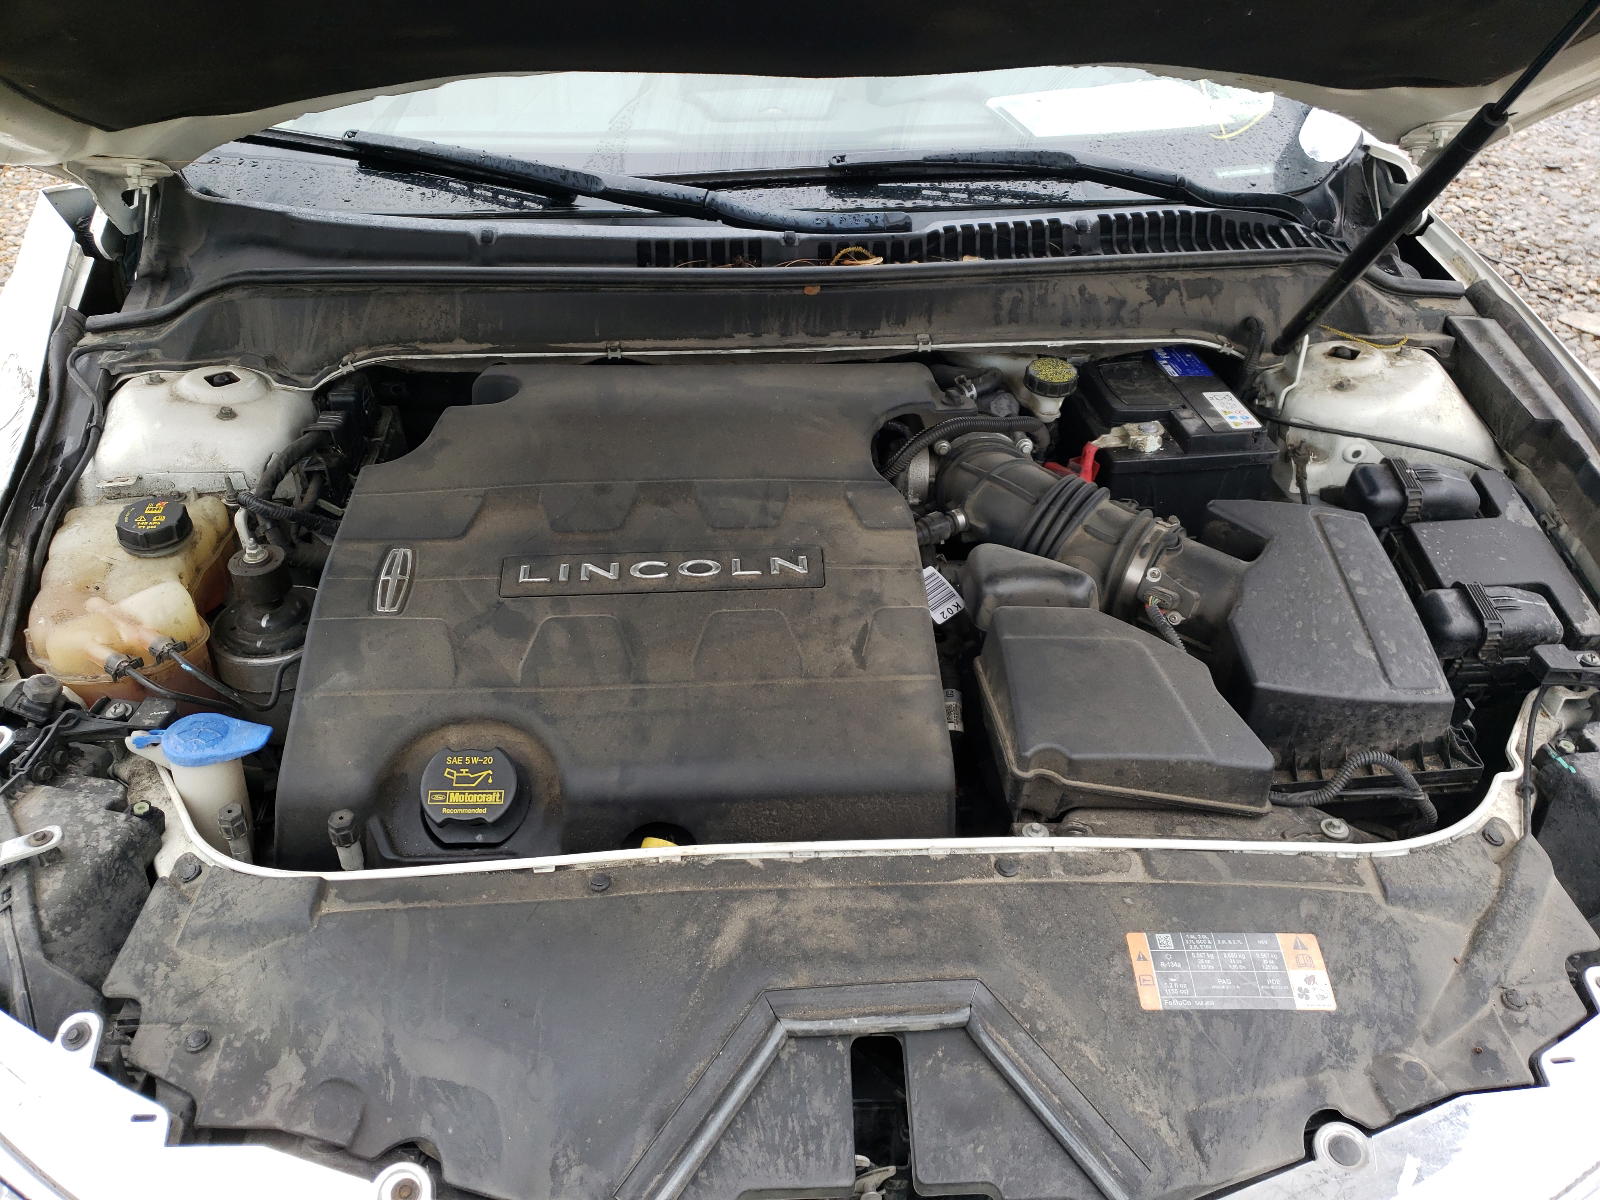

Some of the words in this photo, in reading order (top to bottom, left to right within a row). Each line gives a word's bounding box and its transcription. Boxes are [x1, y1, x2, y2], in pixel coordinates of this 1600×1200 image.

[519, 556, 808, 583] LINCOLN
[940, 602, 962, 620] K02
[446, 756, 463, 765] SAE
[465, 756, 494, 765] 5W-20
[449, 792, 501, 803] Motorcraft
